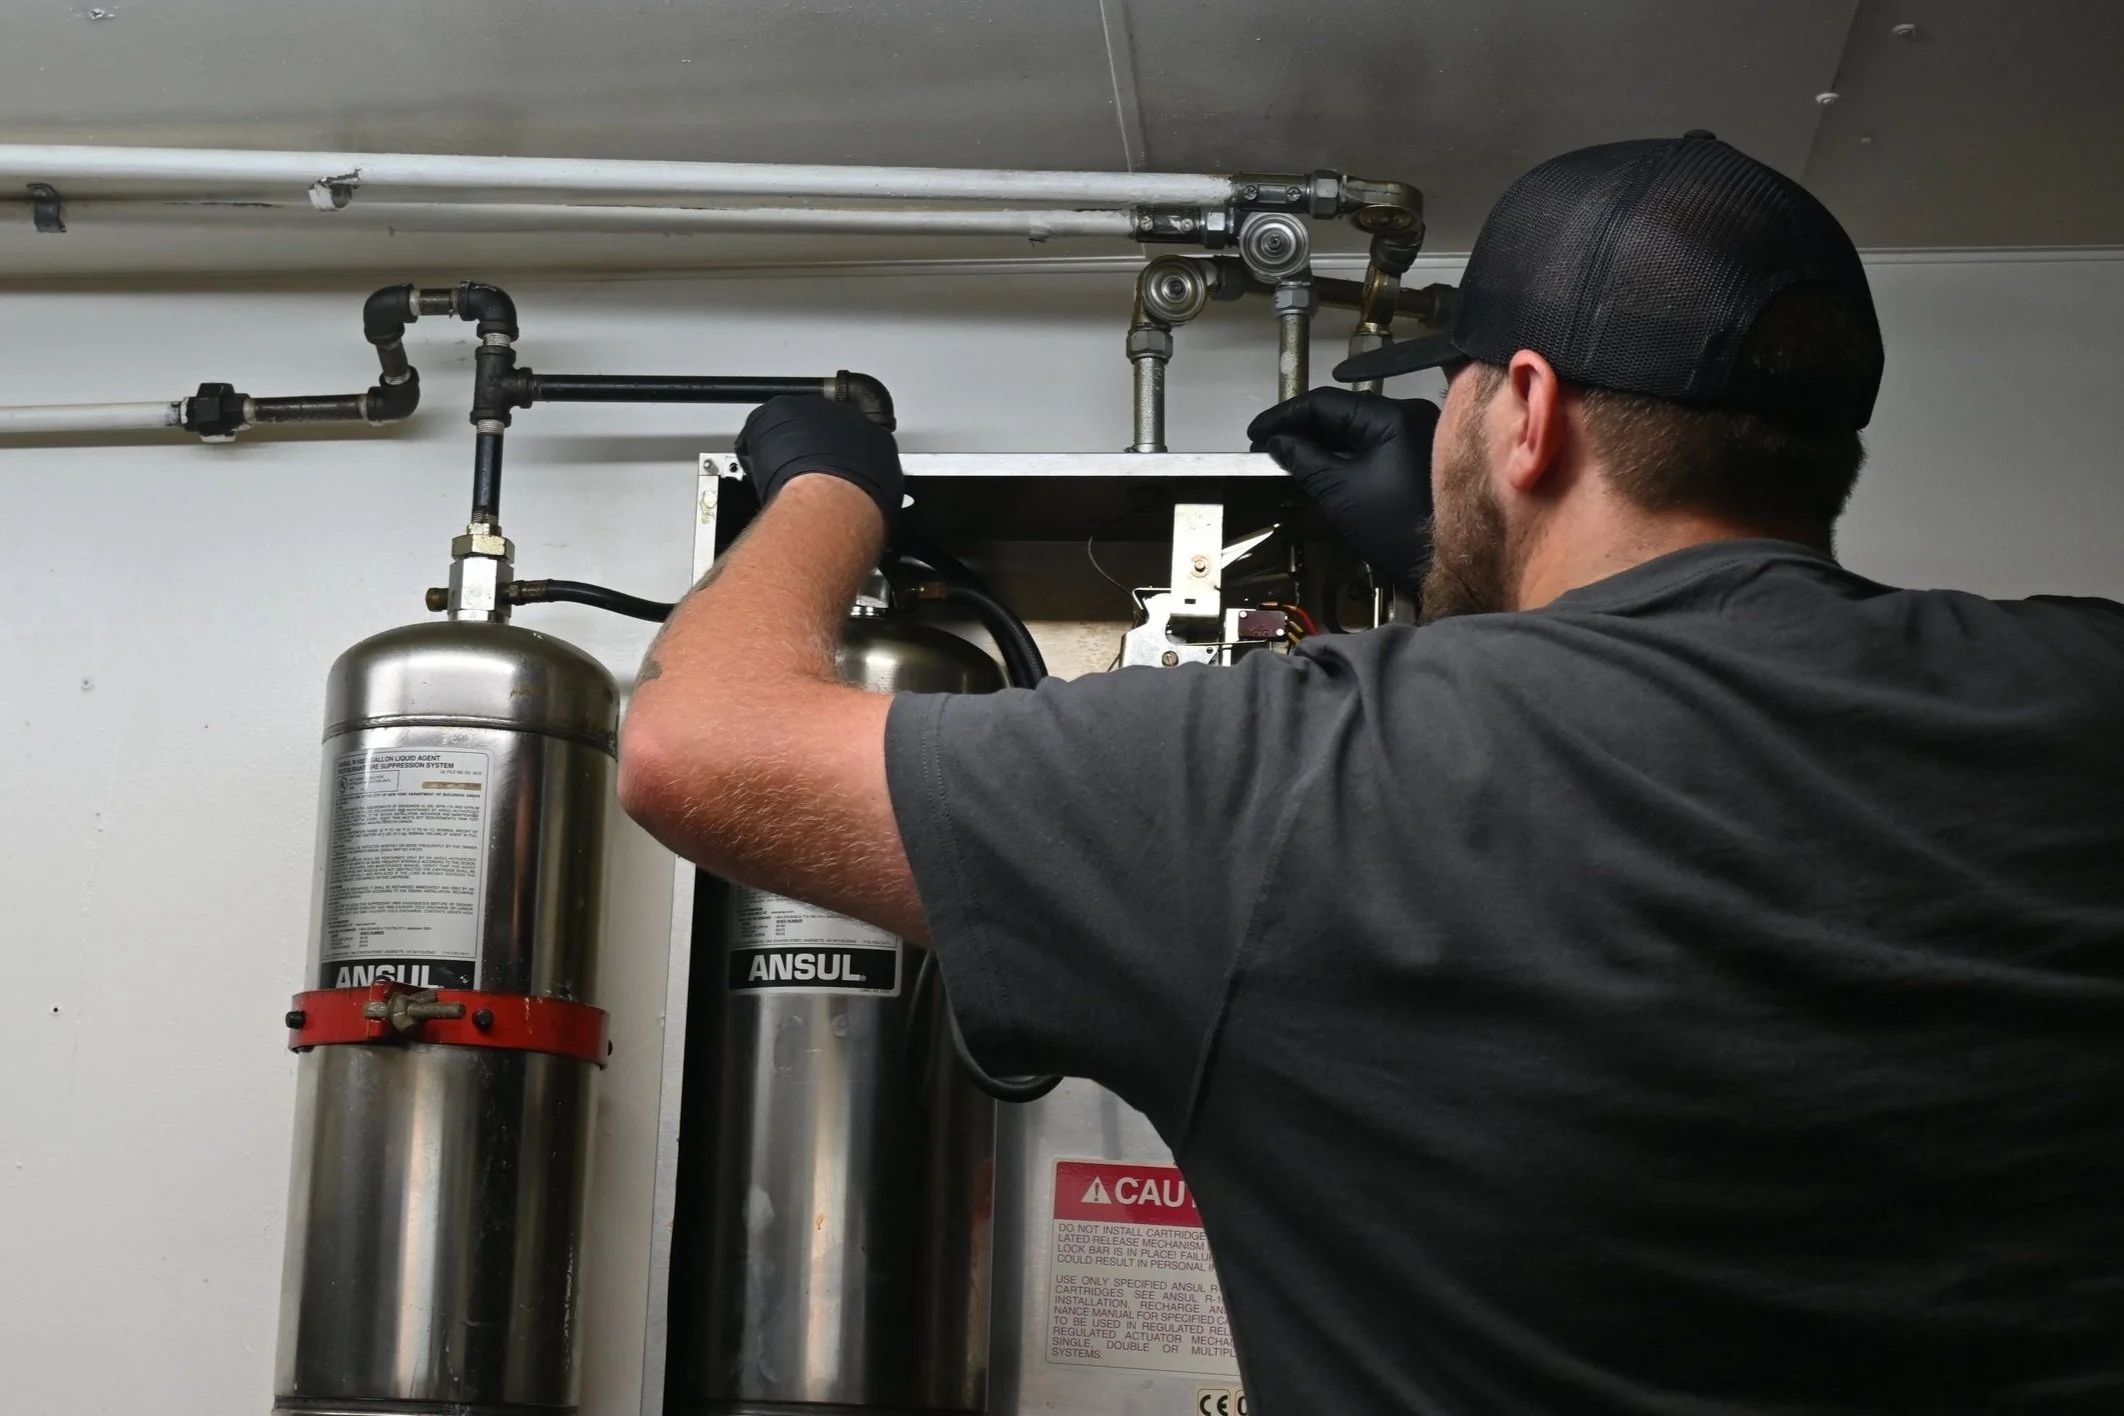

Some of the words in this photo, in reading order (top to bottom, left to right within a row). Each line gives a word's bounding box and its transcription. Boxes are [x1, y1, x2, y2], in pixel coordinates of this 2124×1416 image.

[748, 953, 861, 982] ANSUL
[1115, 1177, 1196, 1208] CAU
[1059, 1224, 1074, 1232] DO
[1078, 1224, 1099, 1233] NOT
[1103, 1226, 1142, 1236] INSTALL
[1146, 1228, 1206, 1240] CARTRIDGE
[1058, 1234, 1090, 1243] LATED
[1093, 1236, 1139, 1246] RELEASE
[1142, 1239, 1204, 1250] MECHANISM
[1058, 1244, 1085, 1254] LOCK
[1089, 1246, 1110, 1255] BAR
[1114, 1247, 1123, 1256] IS
[1127, 1248, 1137, 1257] IN
[1141, 1249, 1176, 1259] PLACE!
[1057, 1254, 1092, 1264] COULD
[1096, 1256, 1134, 1267] RESULT
[1138, 1259, 1148, 1268] IN
[1150, 1260, 1206, 1271] PERSONAL
[1056, 1275, 1076, 1284] USE
[1082, 1276, 1109, 1286] ONLY
[1113, 1278, 1167, 1290] SPECIFIED
[1171, 1282, 1206, 1292] ANSUL
[1135, 1290, 1156, 1300] SEE
[1162, 1292, 1198, 1302] ANSUL
[1054, 1306, 1089, 1316] NANCE
[1092, 1308, 1134, 1319] MANUAL
[1137, 1311, 1158, 1320] FOR
[1161, 1313, 1214, 1324] SPECIFIED
[1141, 1301, 1200, 1313] RECHARGE
[1209, 1306, 1226, 1314] AN
[1053, 1316, 1068, 1325] TO
[1073, 1317, 1087, 1326] BE
[1093, 1319, 1121, 1328] USED
[1126, 1321, 1136, 1330] IN
[1142, 1322, 1204, 1334] REGULATED
[1209, 1326, 1232, 1336] REL
[1053, 1327, 1116, 1339] REGULATED
[1125, 1331, 1182, 1343] ACTUATOR
[1051, 1347, 1103, 1359] SYSTEMS.
[1052, 1337, 1093, 1348] SINGLE,
[1106, 1340, 1150, 1352] DOUBLE
[1163, 1344, 1178, 1354] OR
